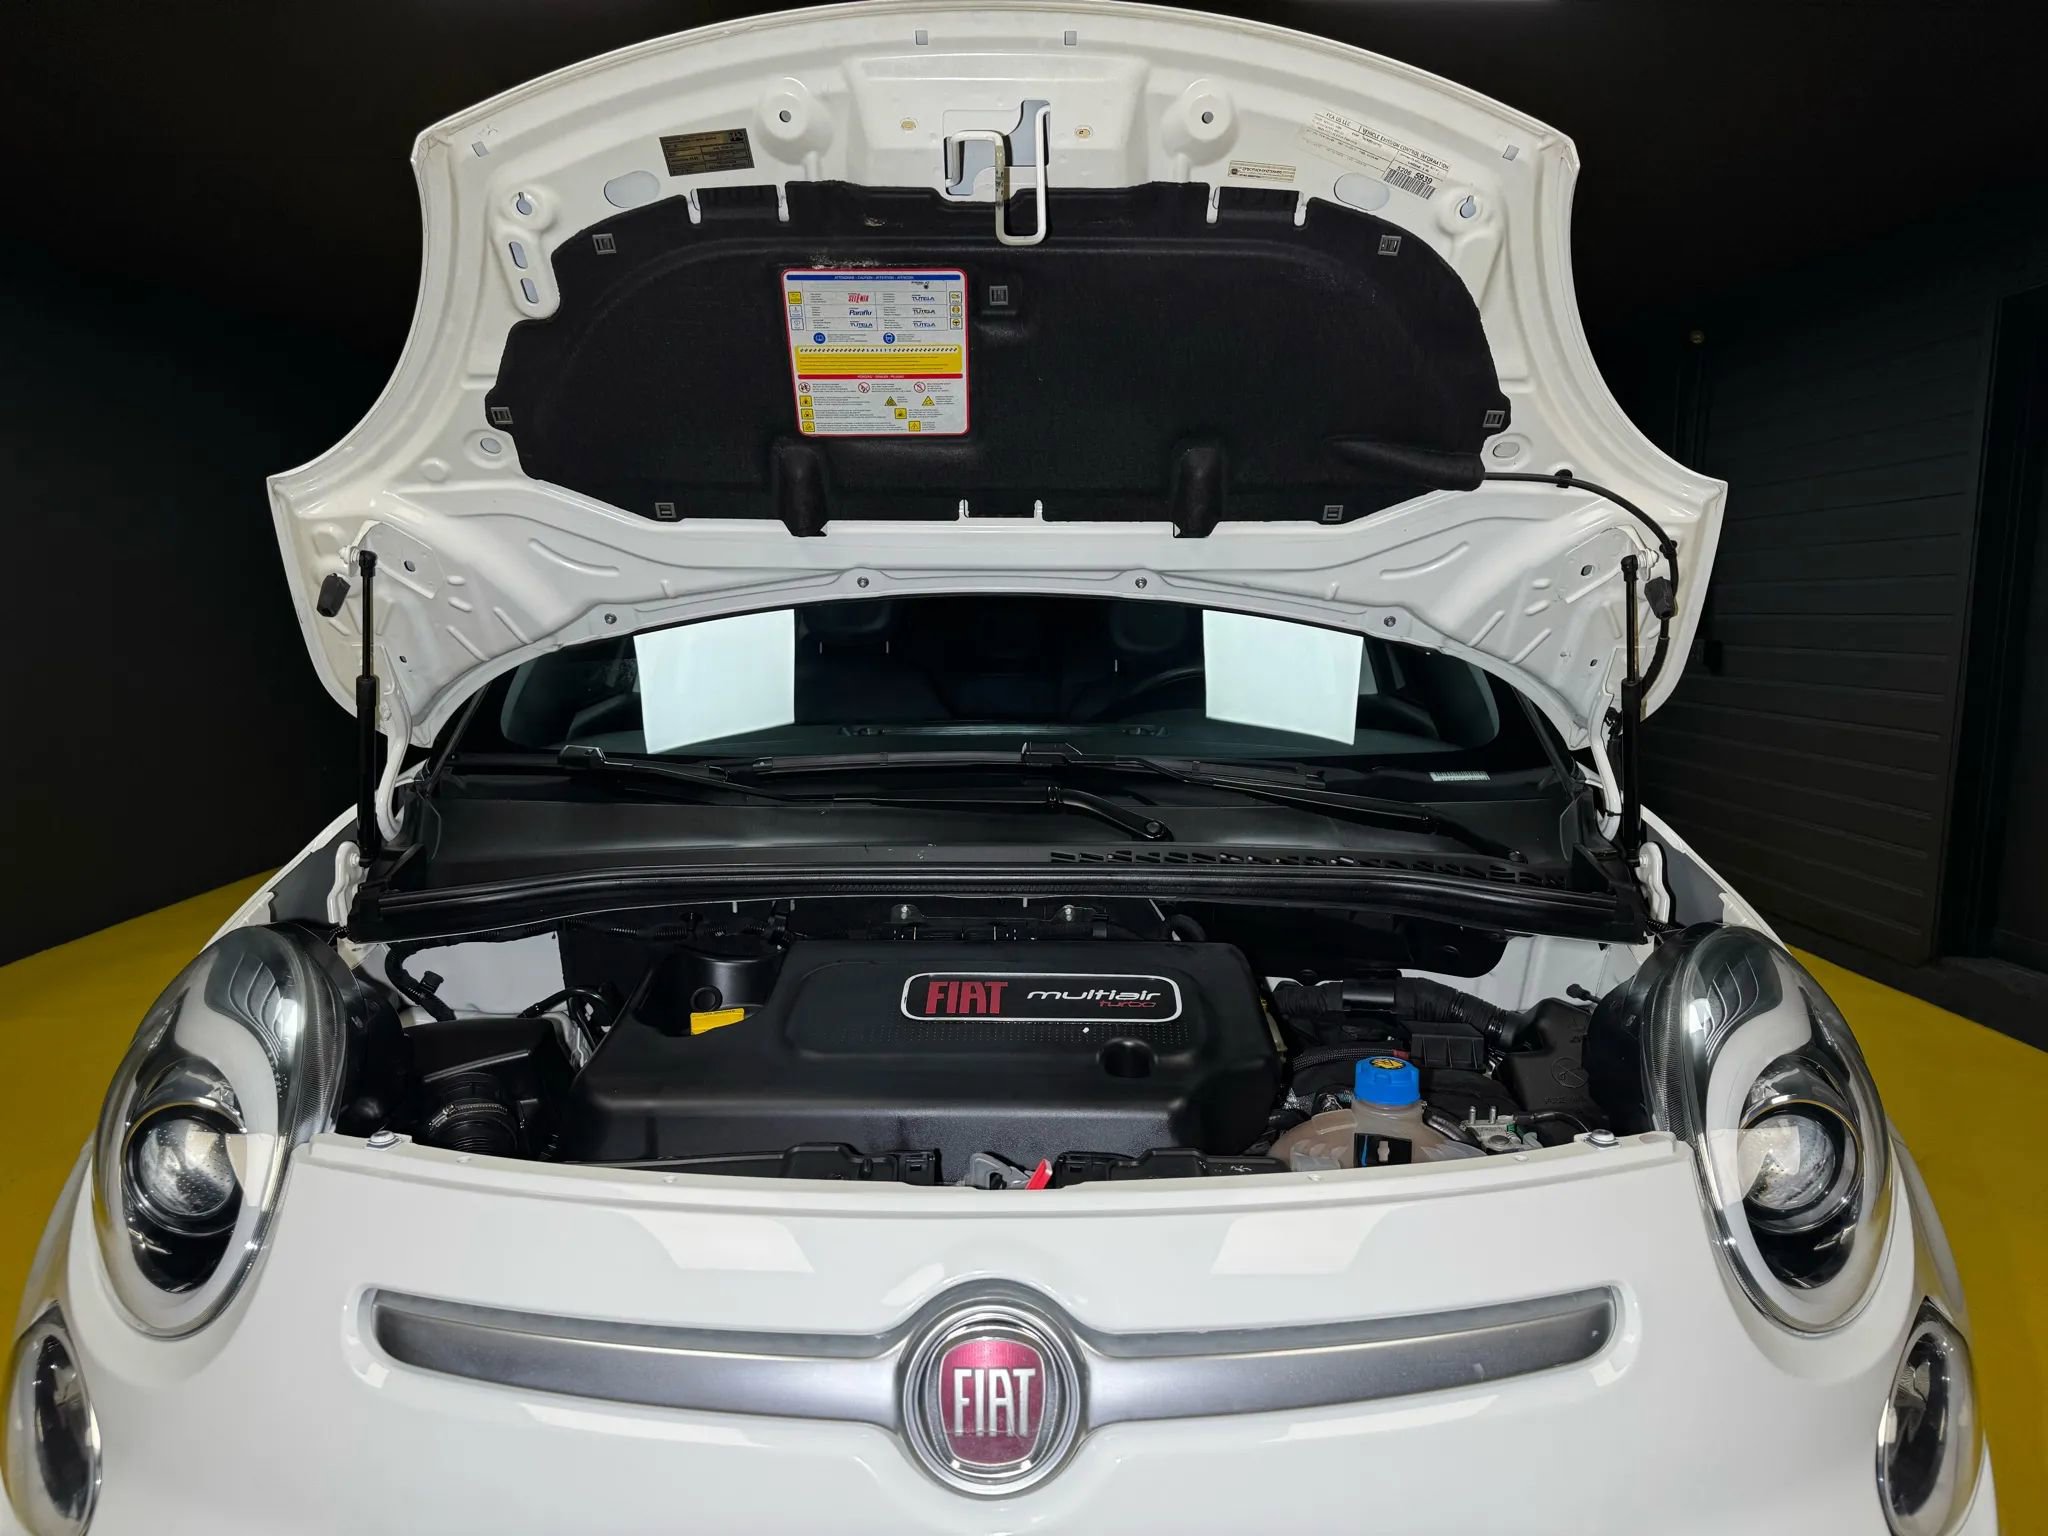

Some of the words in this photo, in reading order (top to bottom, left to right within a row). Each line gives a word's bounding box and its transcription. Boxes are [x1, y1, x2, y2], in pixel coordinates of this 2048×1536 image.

[1362, 128, 1381, 139] VEHICLE
[1400, 143, 1420, 157] CONTROL
[1420, 152, 1449, 169] INFORMATION
[925, 981, 1009, 1014] FIAT
[1027, 989, 1162, 1001] multiair
[1099, 1000, 1157, 1008] turbo
[953, 1367, 1037, 1440] FIAT
